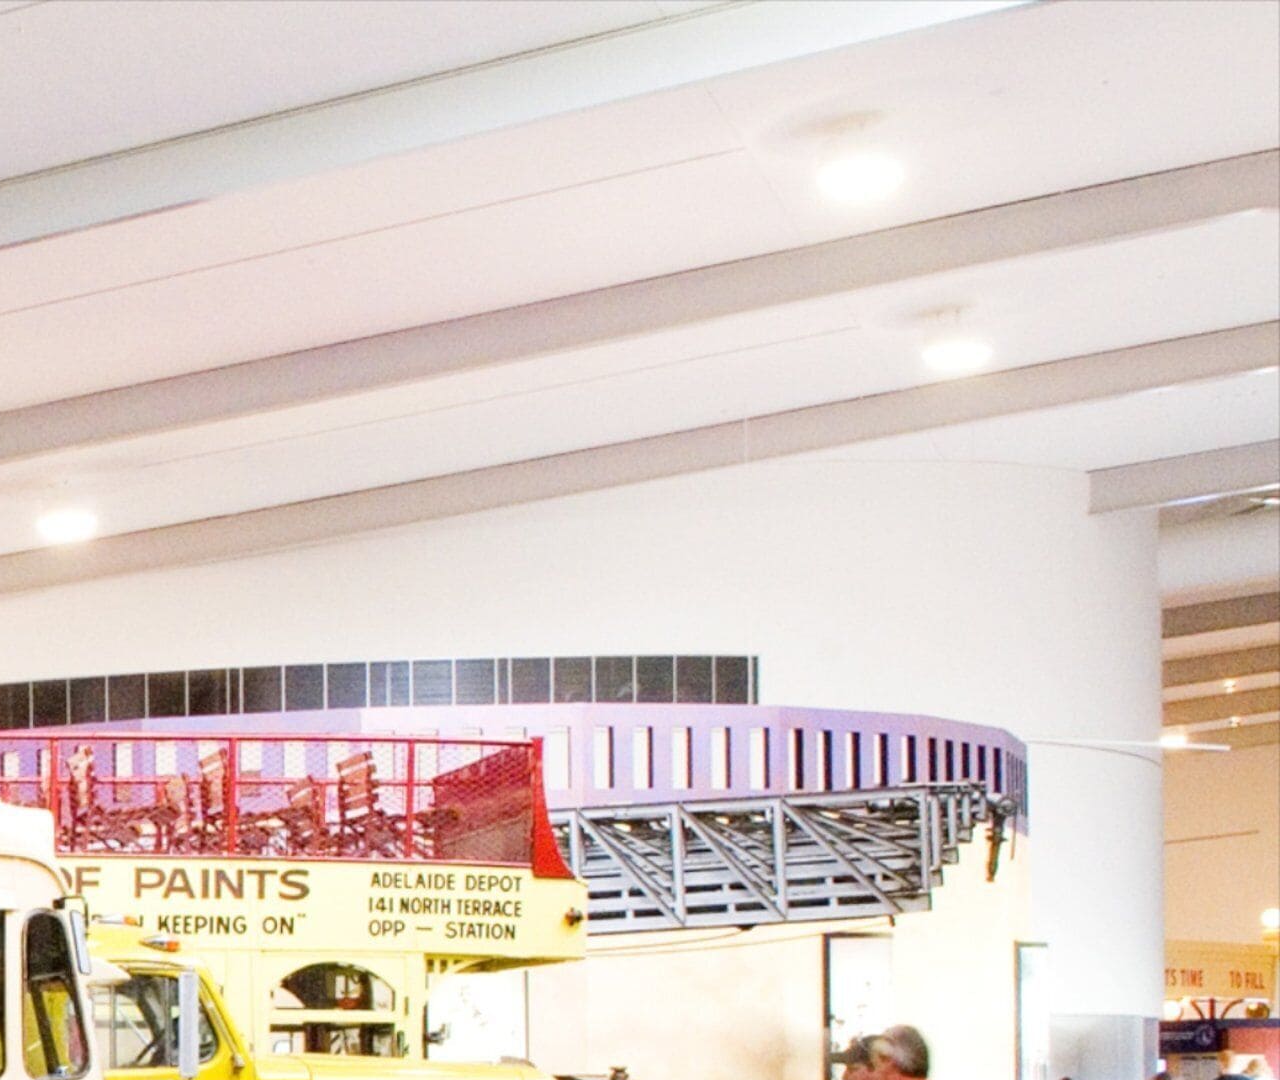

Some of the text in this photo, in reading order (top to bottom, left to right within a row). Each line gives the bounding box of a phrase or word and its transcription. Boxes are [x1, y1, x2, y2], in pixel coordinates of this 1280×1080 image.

[134, 867, 310, 901] PAINTS
[370, 872, 523, 892] ADELAIDE DEPOT
[369, 897, 522, 918] 141 NORTH TERRACE
[157, 914, 247, 934] KEEPING
[368, 920, 405, 937] OPP
[445, 922, 516, 940] STATION
